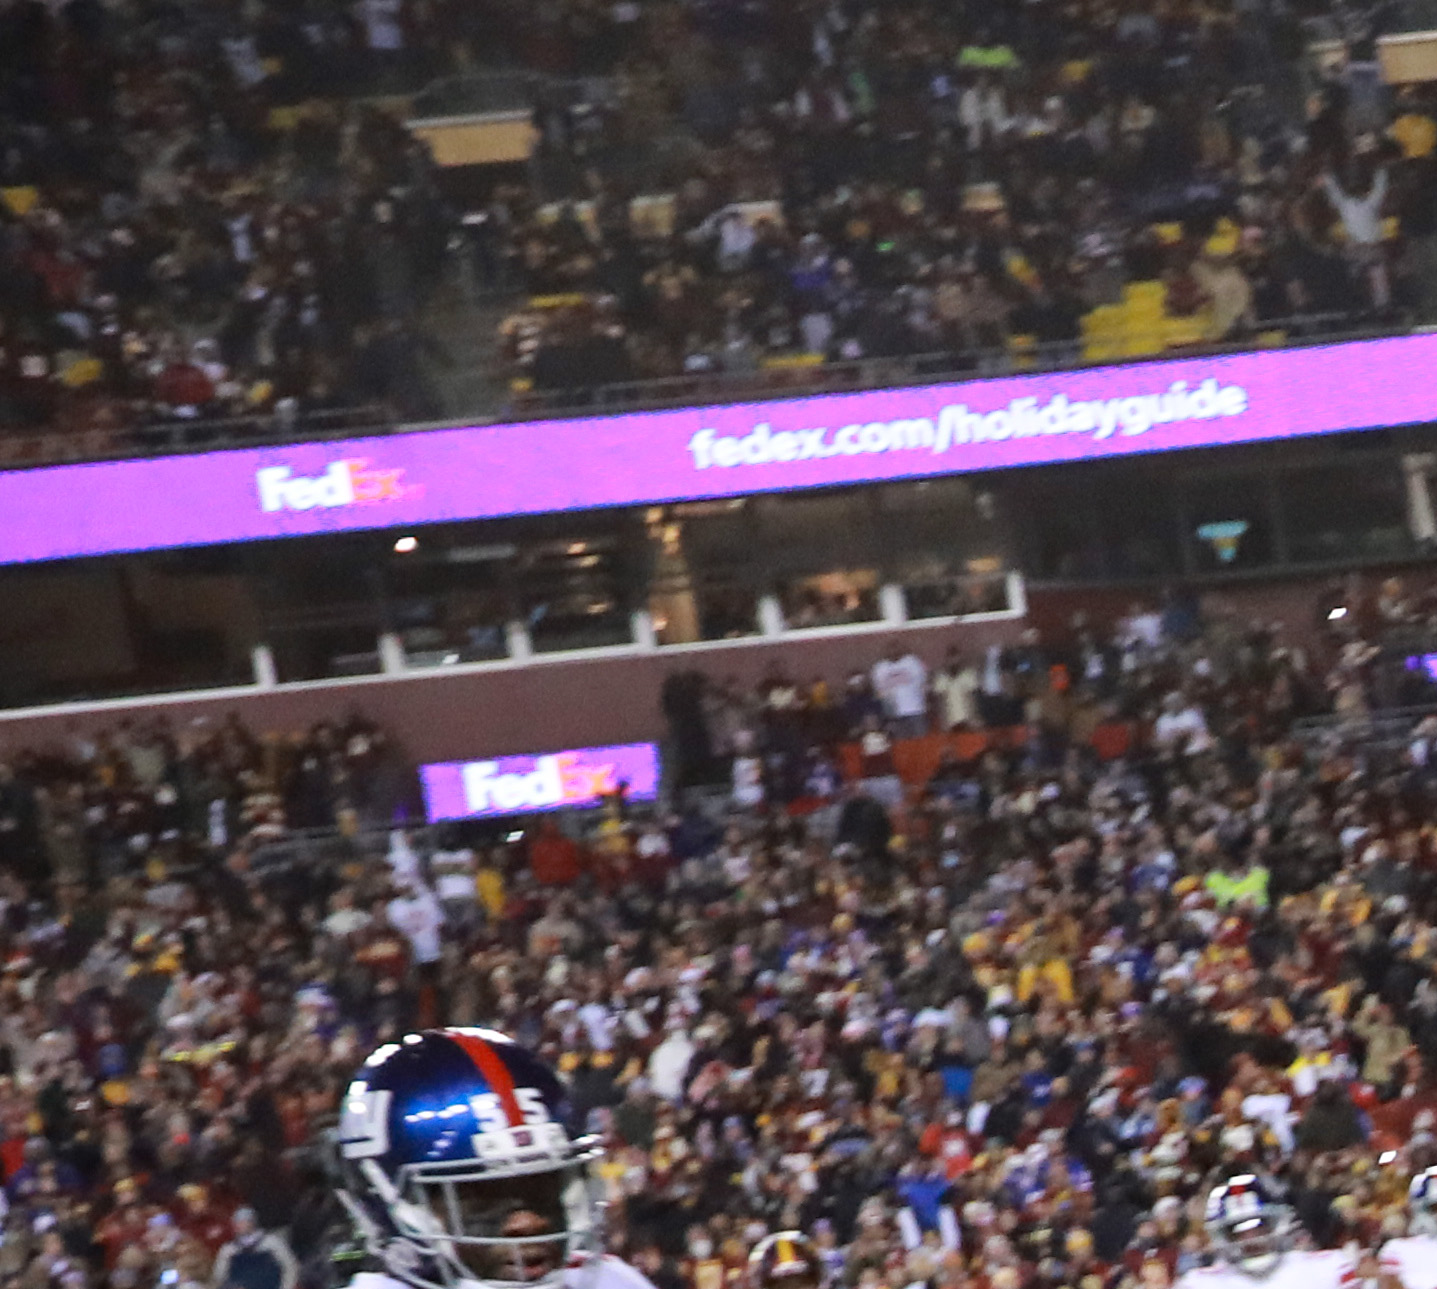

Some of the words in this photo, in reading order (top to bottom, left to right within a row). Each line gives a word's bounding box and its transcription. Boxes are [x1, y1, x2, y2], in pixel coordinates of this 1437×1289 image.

[688, 379, 1248, 470] fedex.com/holidayguide
[256, 457, 410, 513] FedEx
[461, 752, 618, 812] FedEx
